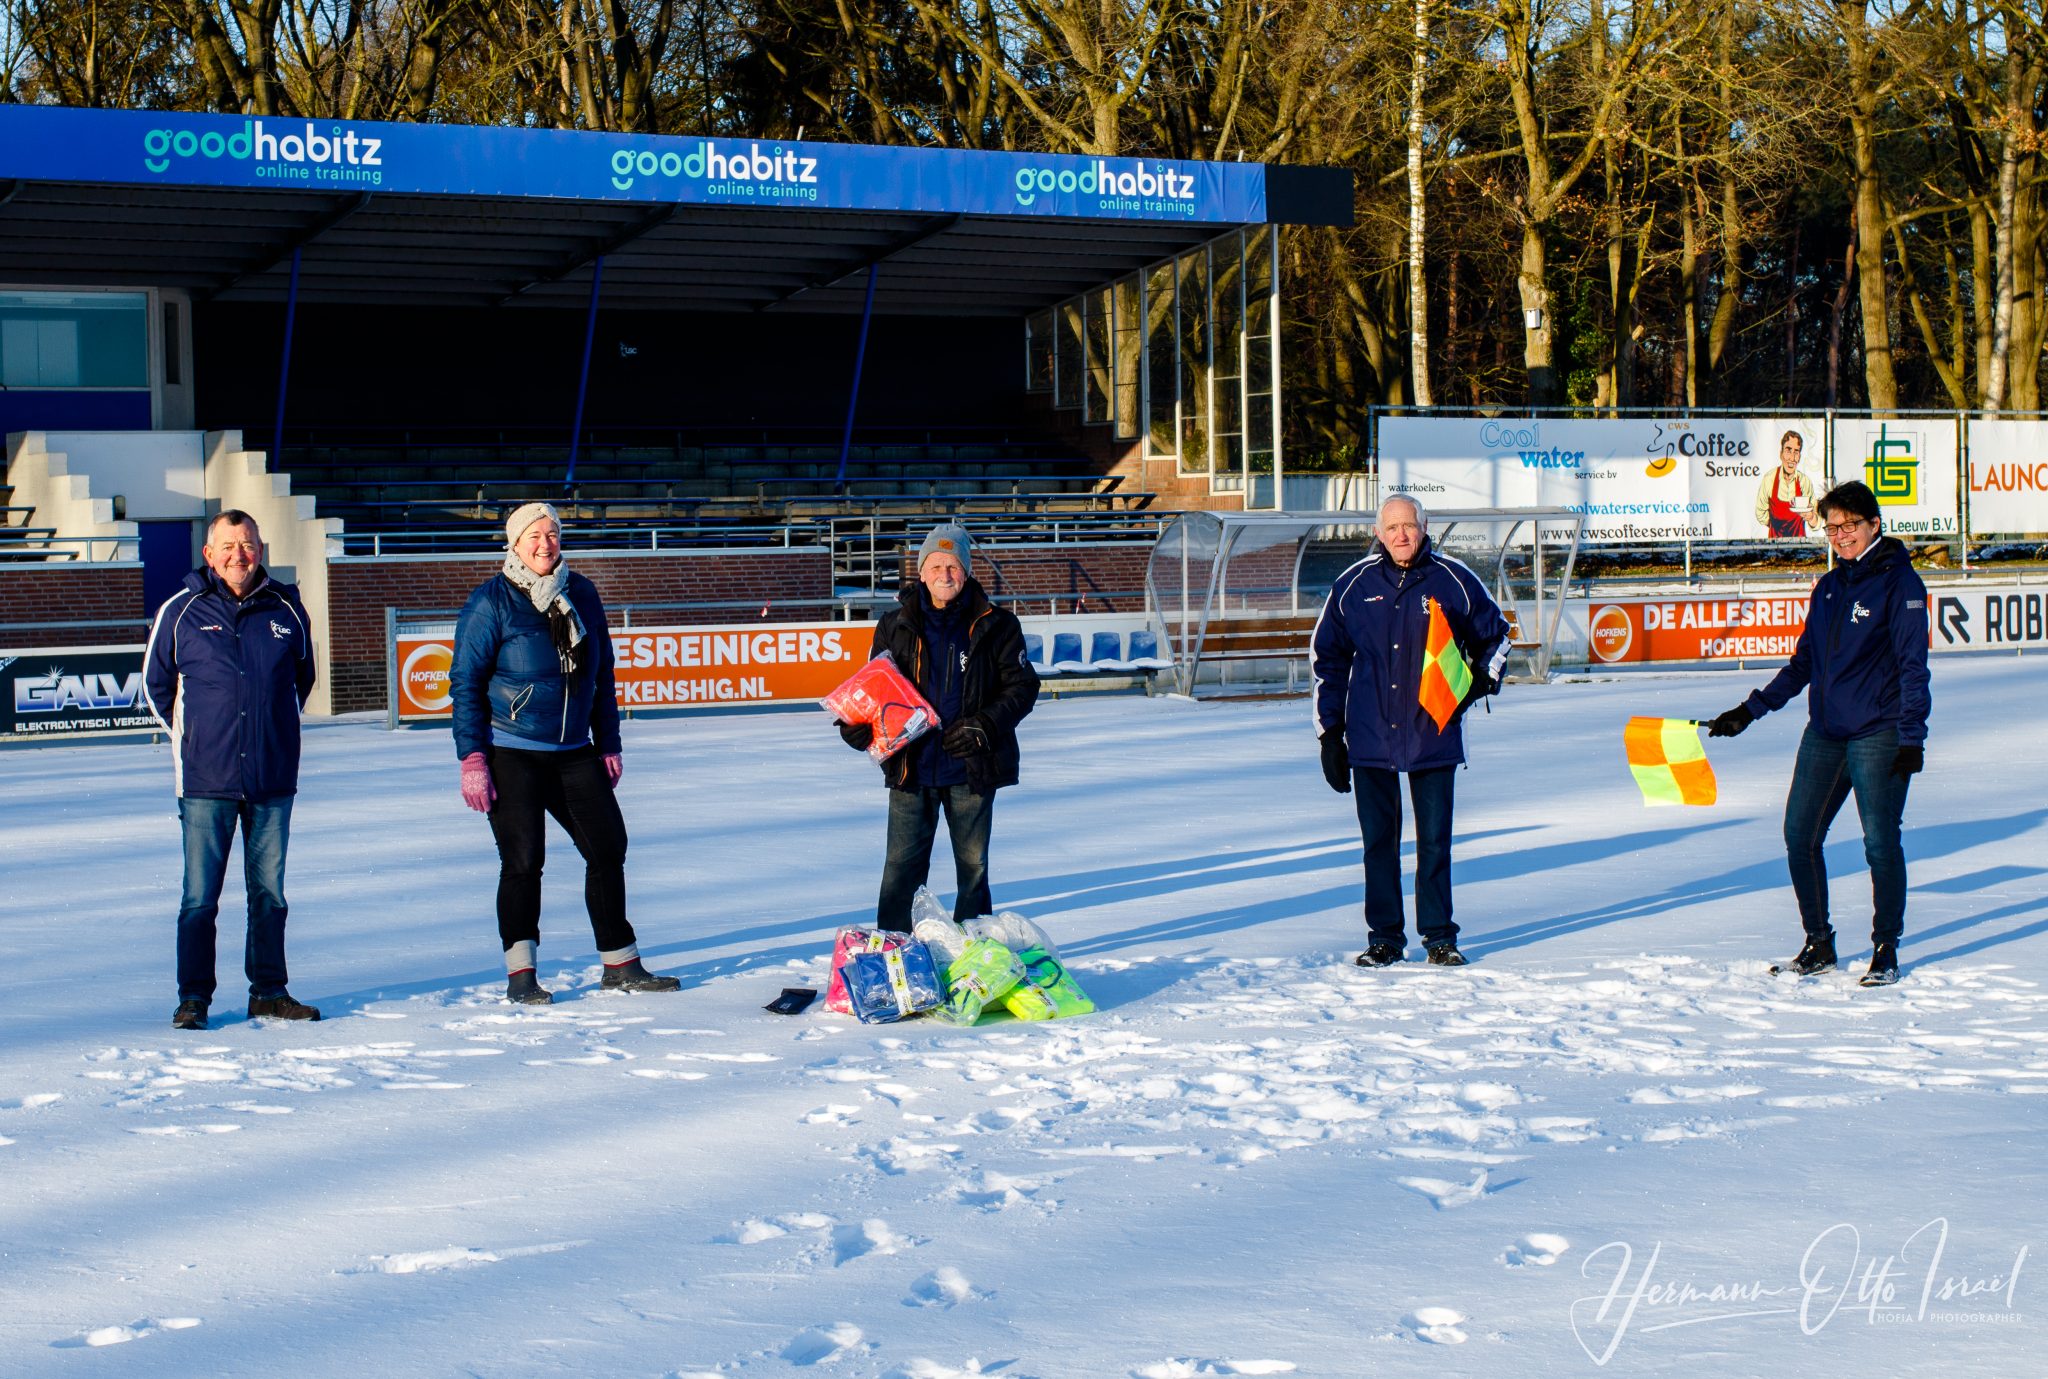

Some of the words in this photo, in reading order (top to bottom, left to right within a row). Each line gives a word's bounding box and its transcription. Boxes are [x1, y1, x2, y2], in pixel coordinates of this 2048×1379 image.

[144, 120, 382, 173] goodhabitz
[256, 163, 309, 179] online
[315, 166, 382, 185] training
[611, 141, 817, 191] goodhabitz
[708, 181, 754, 196] online
[759, 183, 817, 201] training
[1015, 160, 1195, 206] goodhabitz
[1100, 198, 1141, 211] online
[1144, 201, 1195, 215] training
[1480, 421, 1540, 448] Cool
[1678, 432, 1750, 457] Coffee
[1518, 446, 1585, 468] water
[1574, 470, 1605, 480] service
[1607, 469, 1618, 479] bv
[1705, 460, 1760, 477] Service
[1388, 483, 1446, 492] waterkoelers
[1561, 501, 1710, 515] oolwaterservice.com
[1540, 523, 1713, 540] wwwcwscoffeeservice.nl
[1890, 518, 1929, 533] Leeuw
[1932, 517, 1957, 531] B.V.
[1439, 532, 1487, 543] dspensers
[1644, 604, 1676, 631] DE
[1680, 599, 1811, 629] ALLESREIN
[1986, 593, 2048, 643] ROB
[1596, 627, 1627, 638] HOFKENS
[611, 631, 850, 669] ESREINIGERS.
[1700, 635, 1801, 657] HOFKENSHI
[411, 671, 450, 682] HOFKEN
[14, 671, 149, 714] GALV
[615, 677, 772, 703] FKENSHIG.NL
[15, 719, 110, 732] ELEKTROLYTISCH
